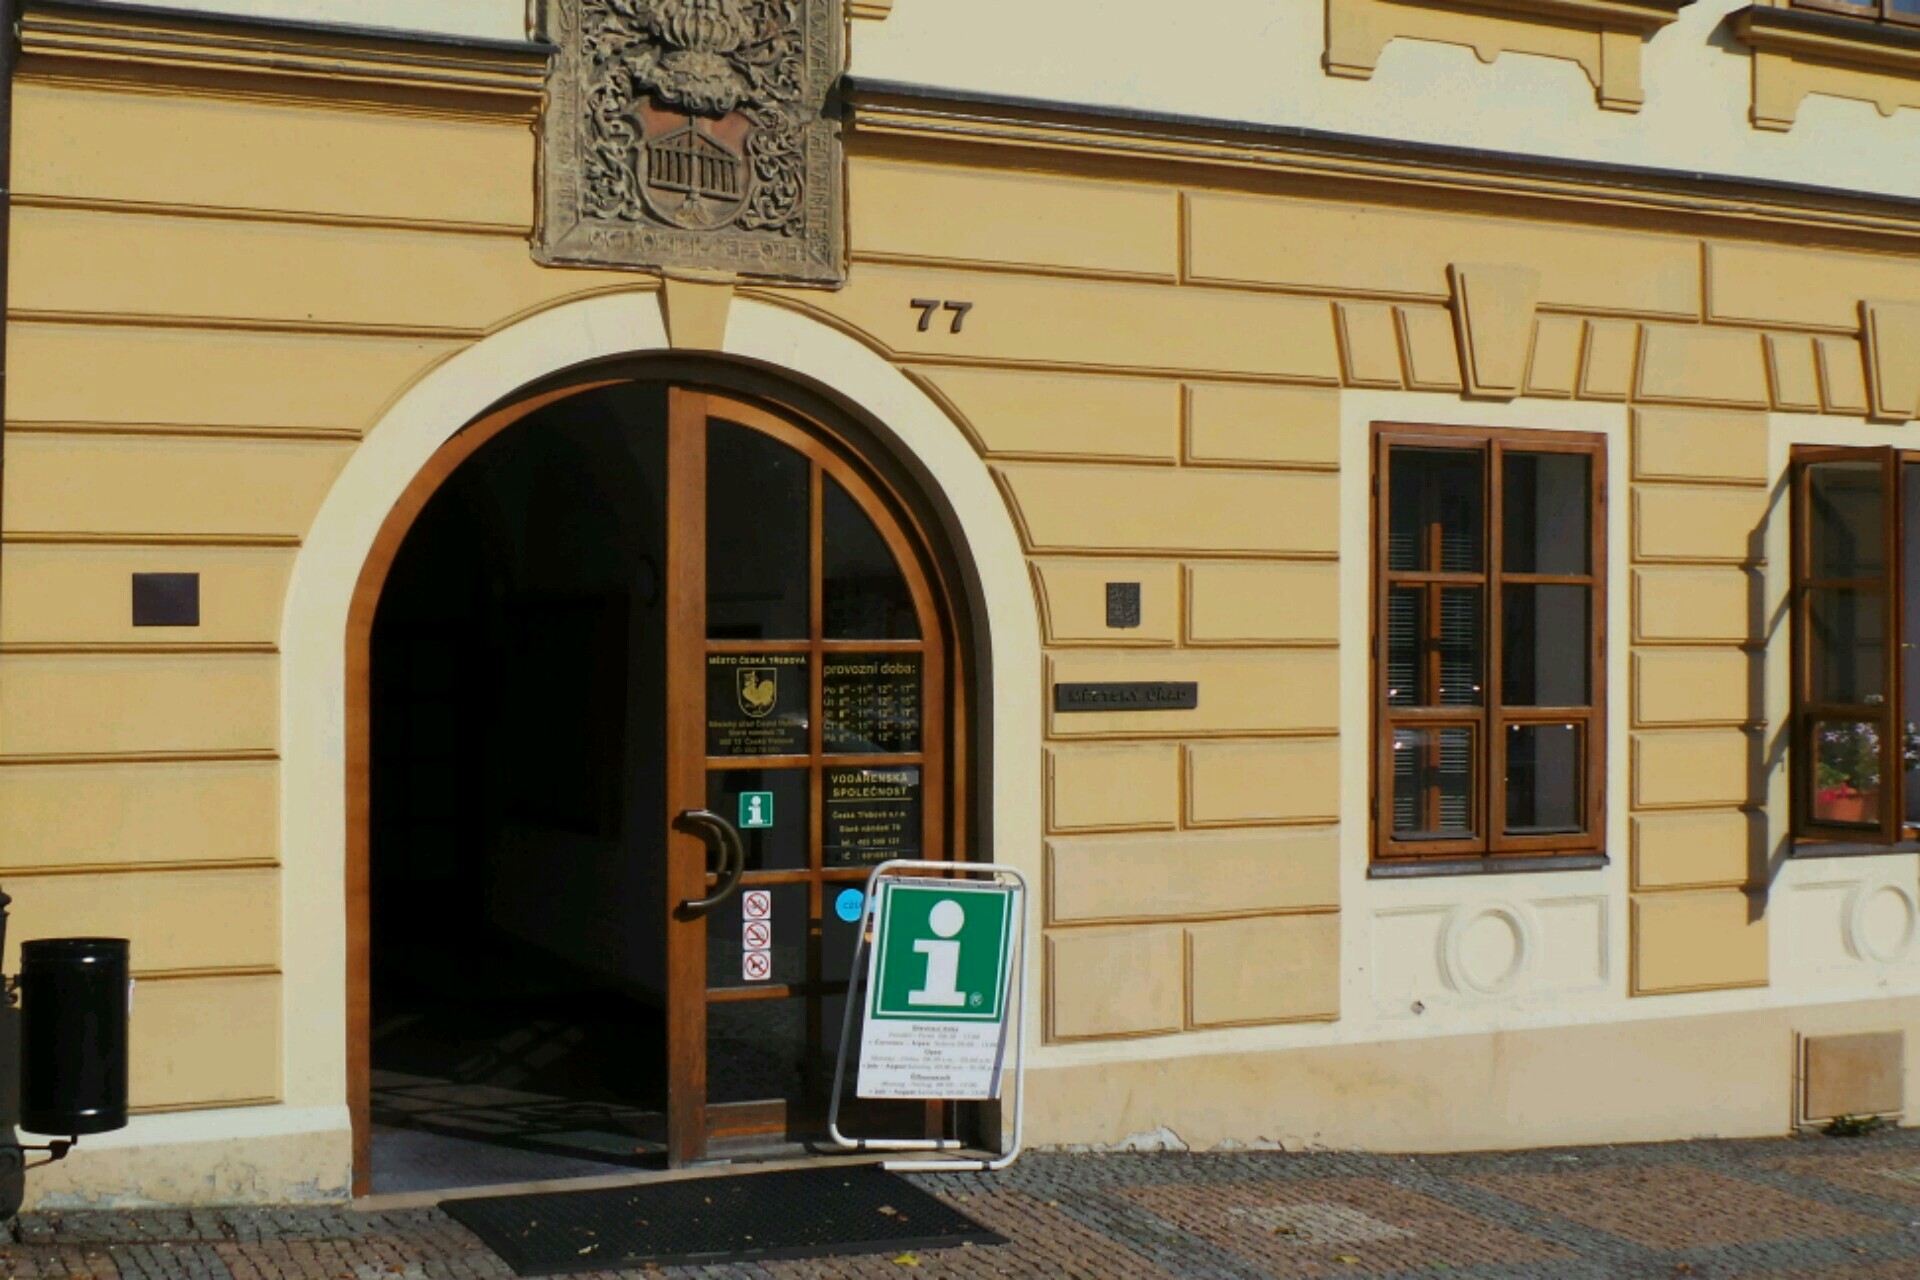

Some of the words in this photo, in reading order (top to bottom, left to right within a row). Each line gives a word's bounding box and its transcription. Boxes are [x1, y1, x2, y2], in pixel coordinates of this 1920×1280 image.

[911, 299, 972, 333] 77
[708, 655, 737, 664] MĚSTO
[738, 655, 767, 664] ČESKÁ
[769, 655, 806, 664] TŘEBOVÁ
[823, 662, 878, 678] provozní
[880, 662, 916, 674] doba:
[831, 773, 908, 784] VODÁRENSKÁ
[832, 786, 907, 797] SPOLEČNOST
